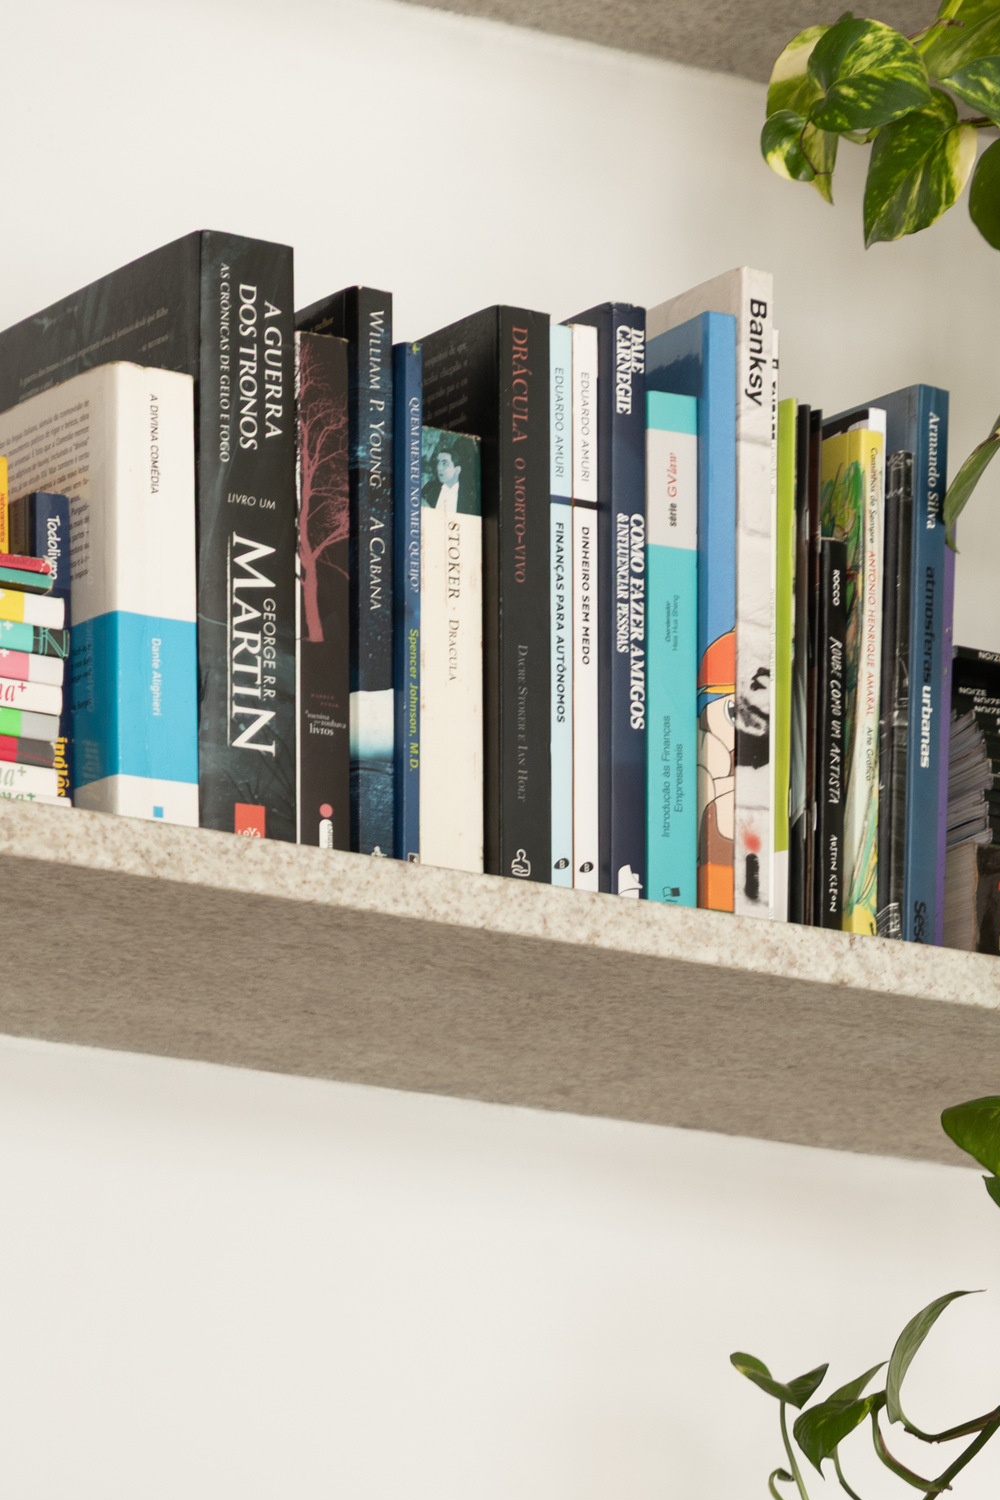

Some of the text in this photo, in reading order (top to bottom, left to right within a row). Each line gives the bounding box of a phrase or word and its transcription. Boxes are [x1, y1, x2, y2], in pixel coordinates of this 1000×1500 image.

[219, 282, 232, 462] CRÔNICAS GELO FOGO
[238, 283, 258, 450] DOS TRONOS
[264, 326, 283, 439] GUERRA
[369, 310, 386, 488] WILLIAM YOUNG
[616, 324, 632, 415] CARNEGIE
[630, 327, 645, 374] DALE
[745, 298, 768, 407] Banksy
[149, 404, 160, 494] DIVINA COMÉDIA
[511, 326, 532, 583] DRÁCULA MORTO-VIVO
[554, 367, 565, 478] EDUARDO AMURI
[580, 372, 590, 482] EDUARDO AMURI
[926, 411, 941, 529] Armando Silva
[228, 493, 256, 506] LIVRO
[369, 537, 386, 610] CABANA
[448, 521, 460, 682] STOKER DRACULA
[555, 522, 566, 724] FINANÇAS PARA AUTÔNOMOS
[581, 526, 591, 665] DINHEIRO SEM MEDO
[629, 513, 645, 730] COMO FAZER AMIGOS
[150, 637, 162, 716] Dante Alighieri
[232, 531, 276, 757] MARTIN
[262, 598, 277, 669] GEORGE
[408, 628, 419, 678] Spencer
[920, 566, 936, 768] atmosferas urbanas
[517, 644, 528, 802] DACRE HOLT
[866, 672, 875, 715] AMARAL
[828, 743, 841, 803] ARTISTA
